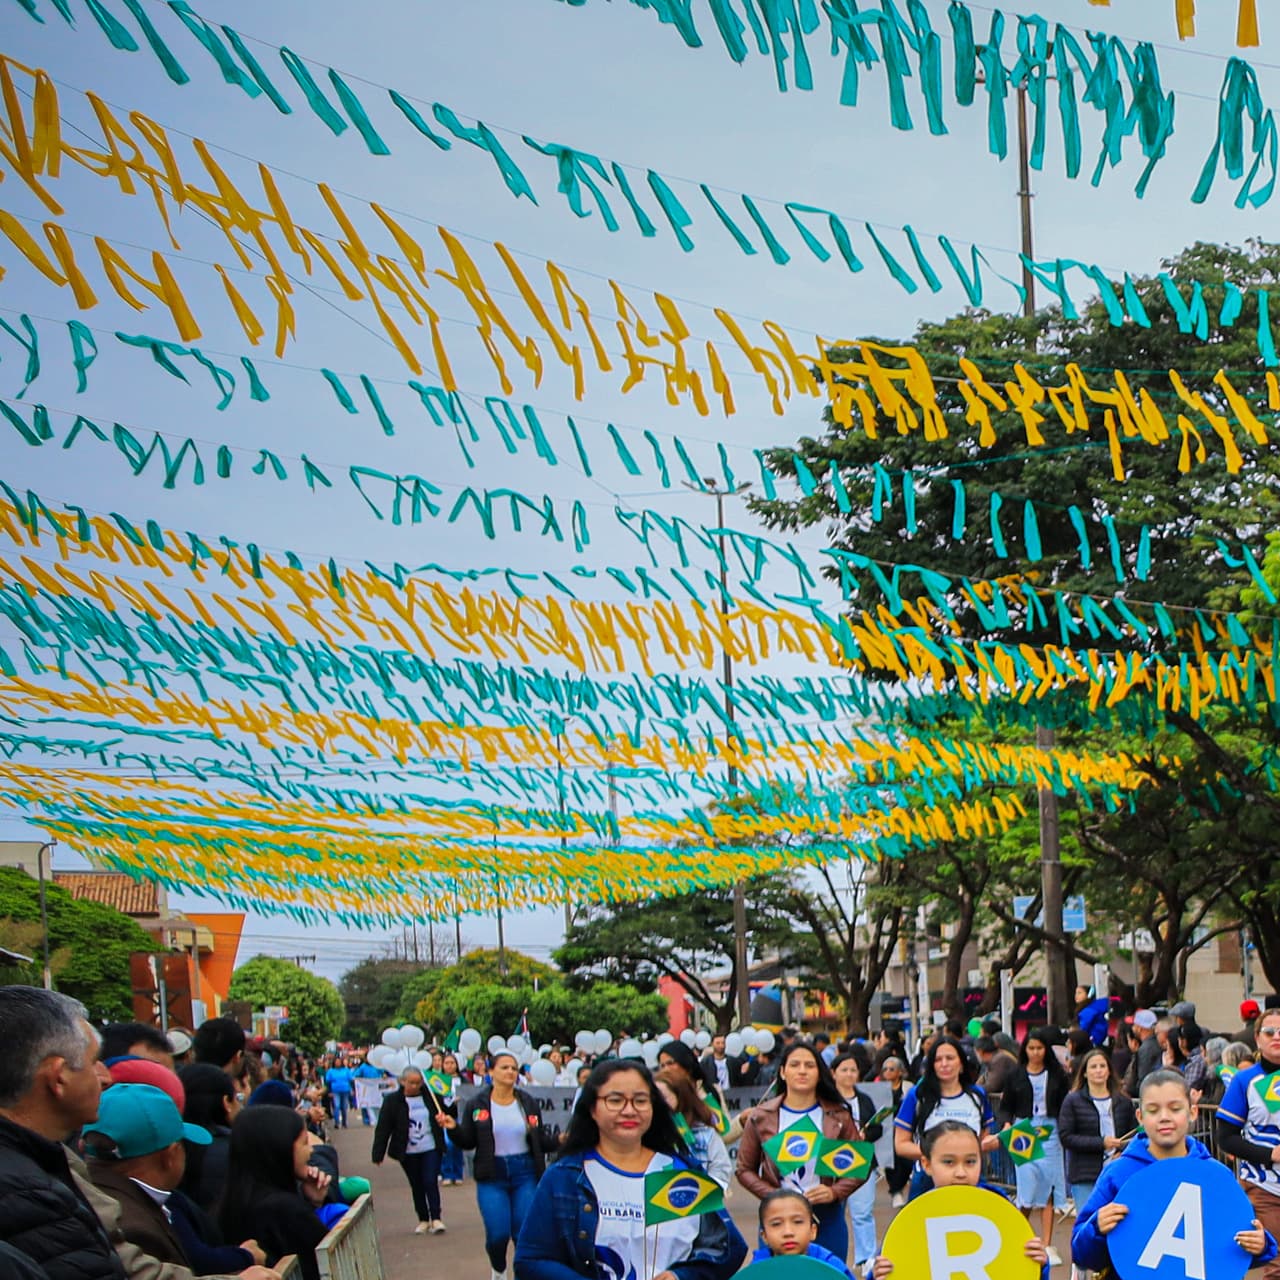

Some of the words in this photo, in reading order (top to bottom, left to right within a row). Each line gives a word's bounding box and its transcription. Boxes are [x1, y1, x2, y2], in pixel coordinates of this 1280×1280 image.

[600, 1207, 612, 1217] UI
[615, 1208, 645, 1218] BARB
[1137, 1182, 1206, 1280] A
